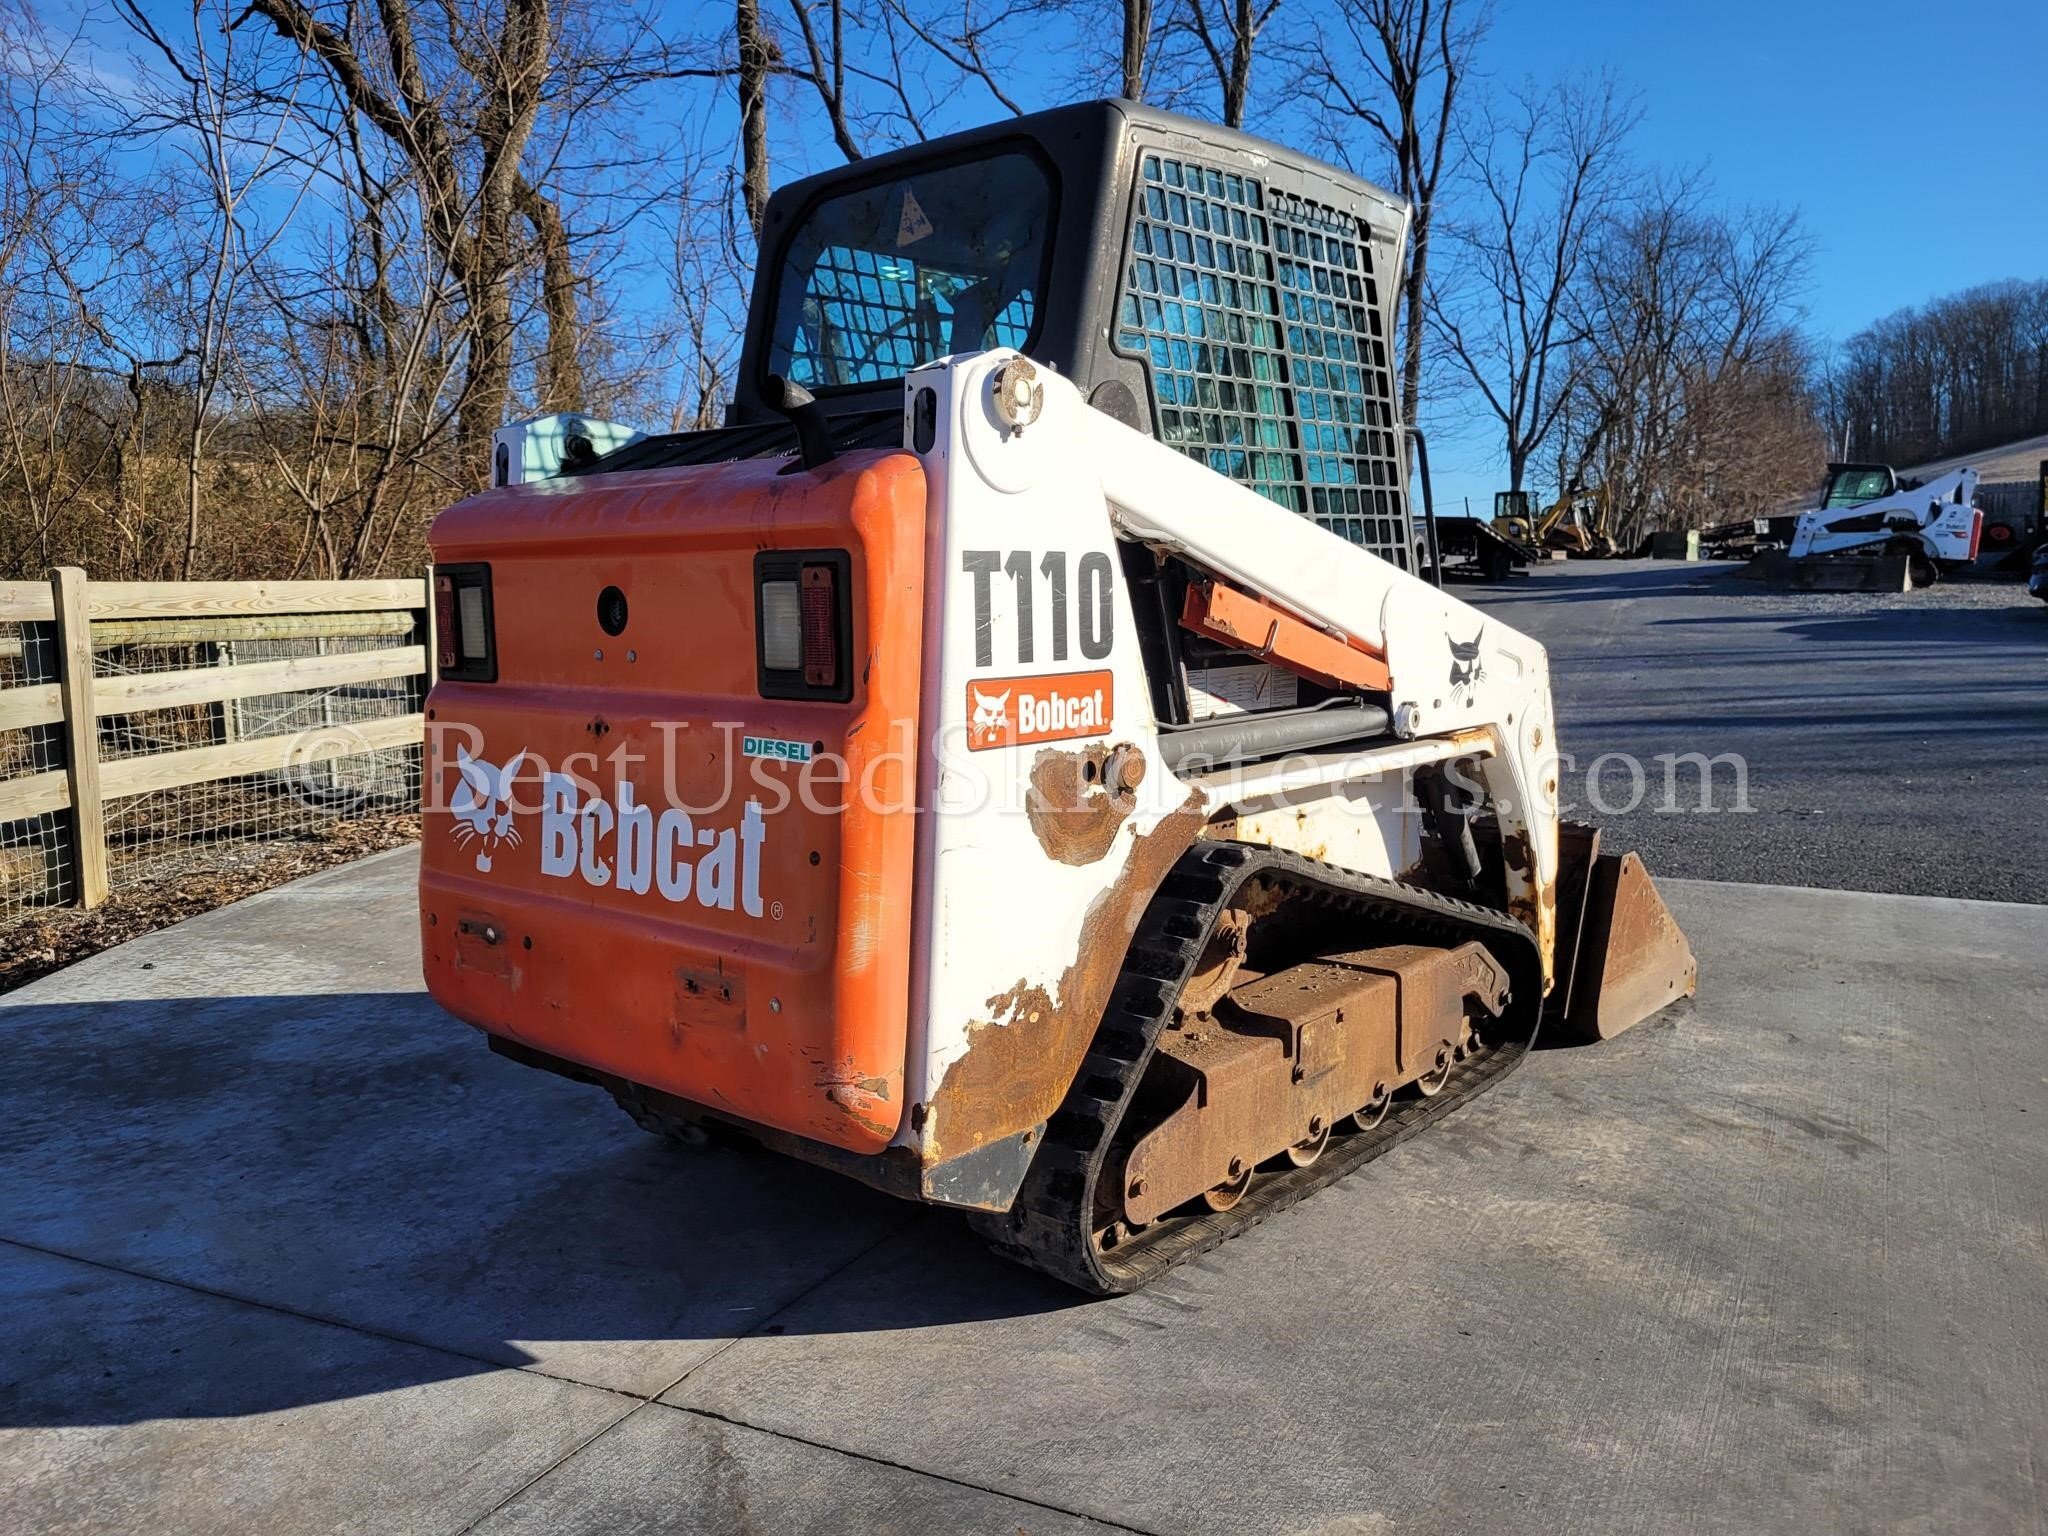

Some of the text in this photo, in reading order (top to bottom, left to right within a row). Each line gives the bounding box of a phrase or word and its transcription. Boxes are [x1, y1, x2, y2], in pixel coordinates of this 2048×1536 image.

[962, 550, 1114, 667] T110
[1018, 689, 1103, 734] Bobcat
[743, 737, 810, 761] DIESEL
